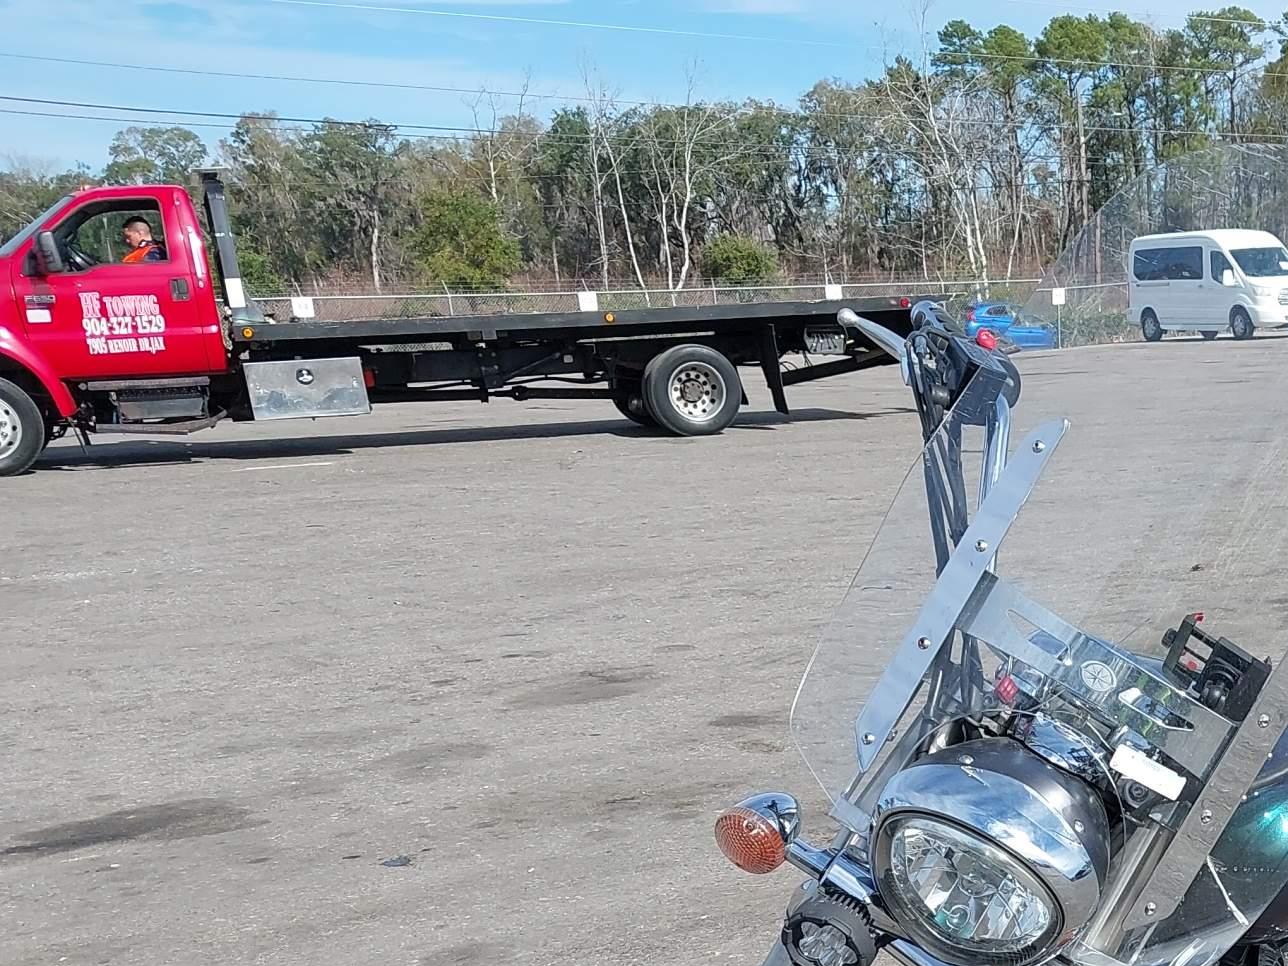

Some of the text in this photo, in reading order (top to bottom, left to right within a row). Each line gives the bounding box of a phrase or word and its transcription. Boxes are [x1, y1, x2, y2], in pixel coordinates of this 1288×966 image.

[103, 295, 160, 317] TOWING
[82, 315, 166, 337] 904-327-1529
[107, 338, 138, 353] RENOIR
